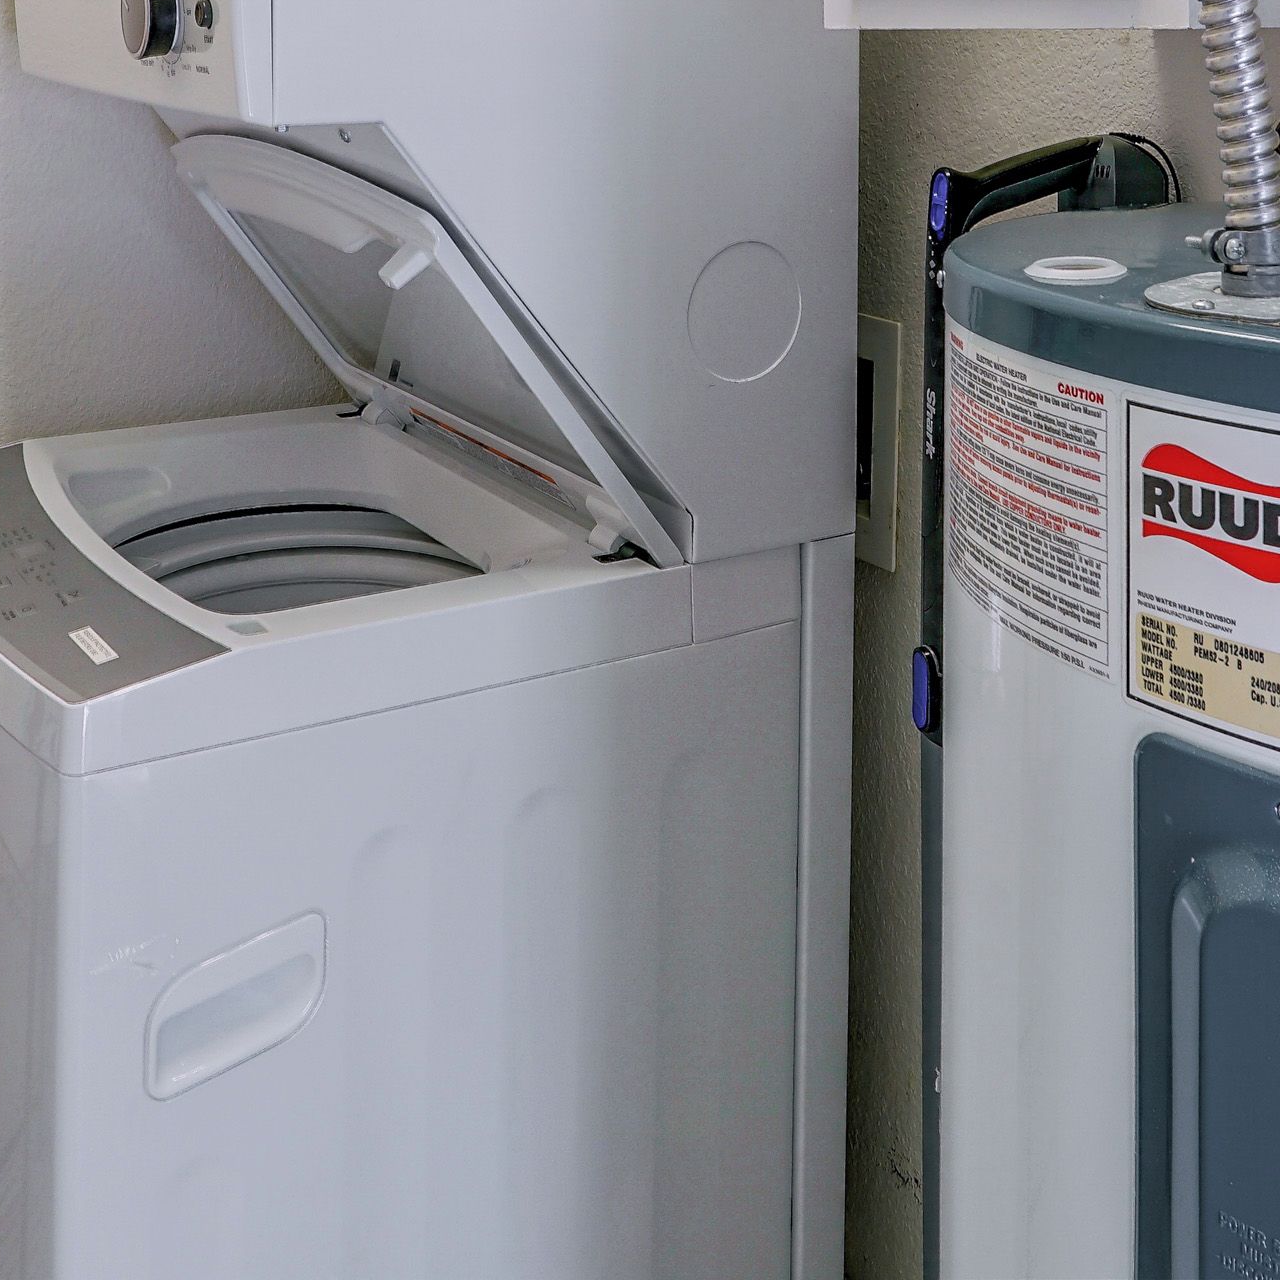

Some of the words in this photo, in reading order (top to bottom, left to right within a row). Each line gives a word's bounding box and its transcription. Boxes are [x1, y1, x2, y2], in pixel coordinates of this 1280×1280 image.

[1057, 382, 1104, 405] CAUTION
[925, 387, 936, 460] Shark
[1137, 590, 1154, 601] RUUD
[1155, 595, 1177, 608] WATER
[1178, 602, 1205, 616] HEATER
[1205, 611, 1236, 626] DIVISION
[1137, 599, 1156, 610] RHEEM
[1157, 605, 1203, 625] MANUFACTURING
[1204, 621, 1233, 634] COMPANY
[1141, 616, 1164, 633] SERIAL
[1166, 624, 1178, 637] NO.
[1194, 632, 1204, 646] RU
[1141, 628, 1165, 646] MODEL
[1166, 636, 1178, 650] NO.
[1141, 640, 1172, 662] WATTAGE
[1141, 653, 1163, 670] UPPER
[1141, 666, 1164, 683] LOWER
[1250, 690, 1268, 705] Cap.
[1143, 678, 1163, 696] TOTAL
